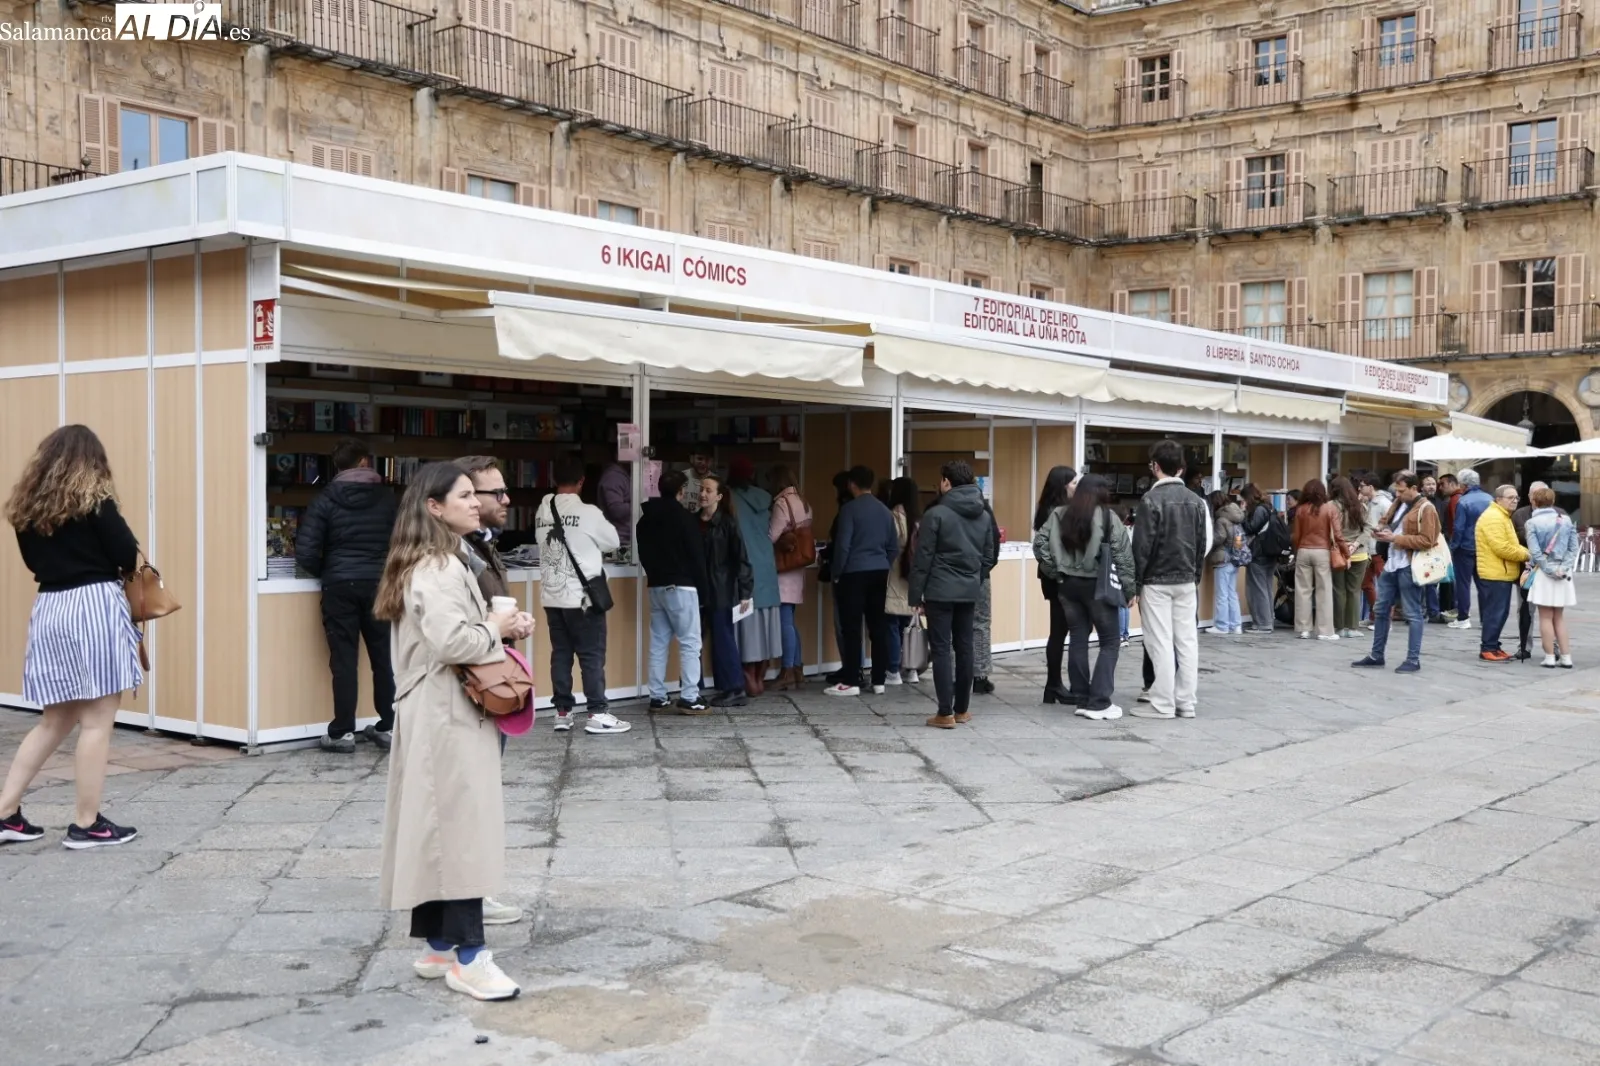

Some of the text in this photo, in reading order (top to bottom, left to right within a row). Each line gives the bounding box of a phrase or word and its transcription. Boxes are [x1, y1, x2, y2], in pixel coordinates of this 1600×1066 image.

[601, 245, 747, 286] 6 IKIGAI CÓMICS
[973, 297, 1079, 329] 7 EDITORIAL DELIRIO
[964, 312, 1020, 336] EDITORIAL
[1022, 323, 1036, 338] LA
[1061, 328, 1087, 345] ROTA
[1205, 345, 1211, 358] 8
[1249, 351, 1276, 368] SANTOS
[1277, 356, 1300, 371] OCHOA
[1364, 365, 1369, 376] 9
[1369, 365, 1396, 381] EDICIONES
[1378, 378, 1417, 394] DE SALAMANCA
